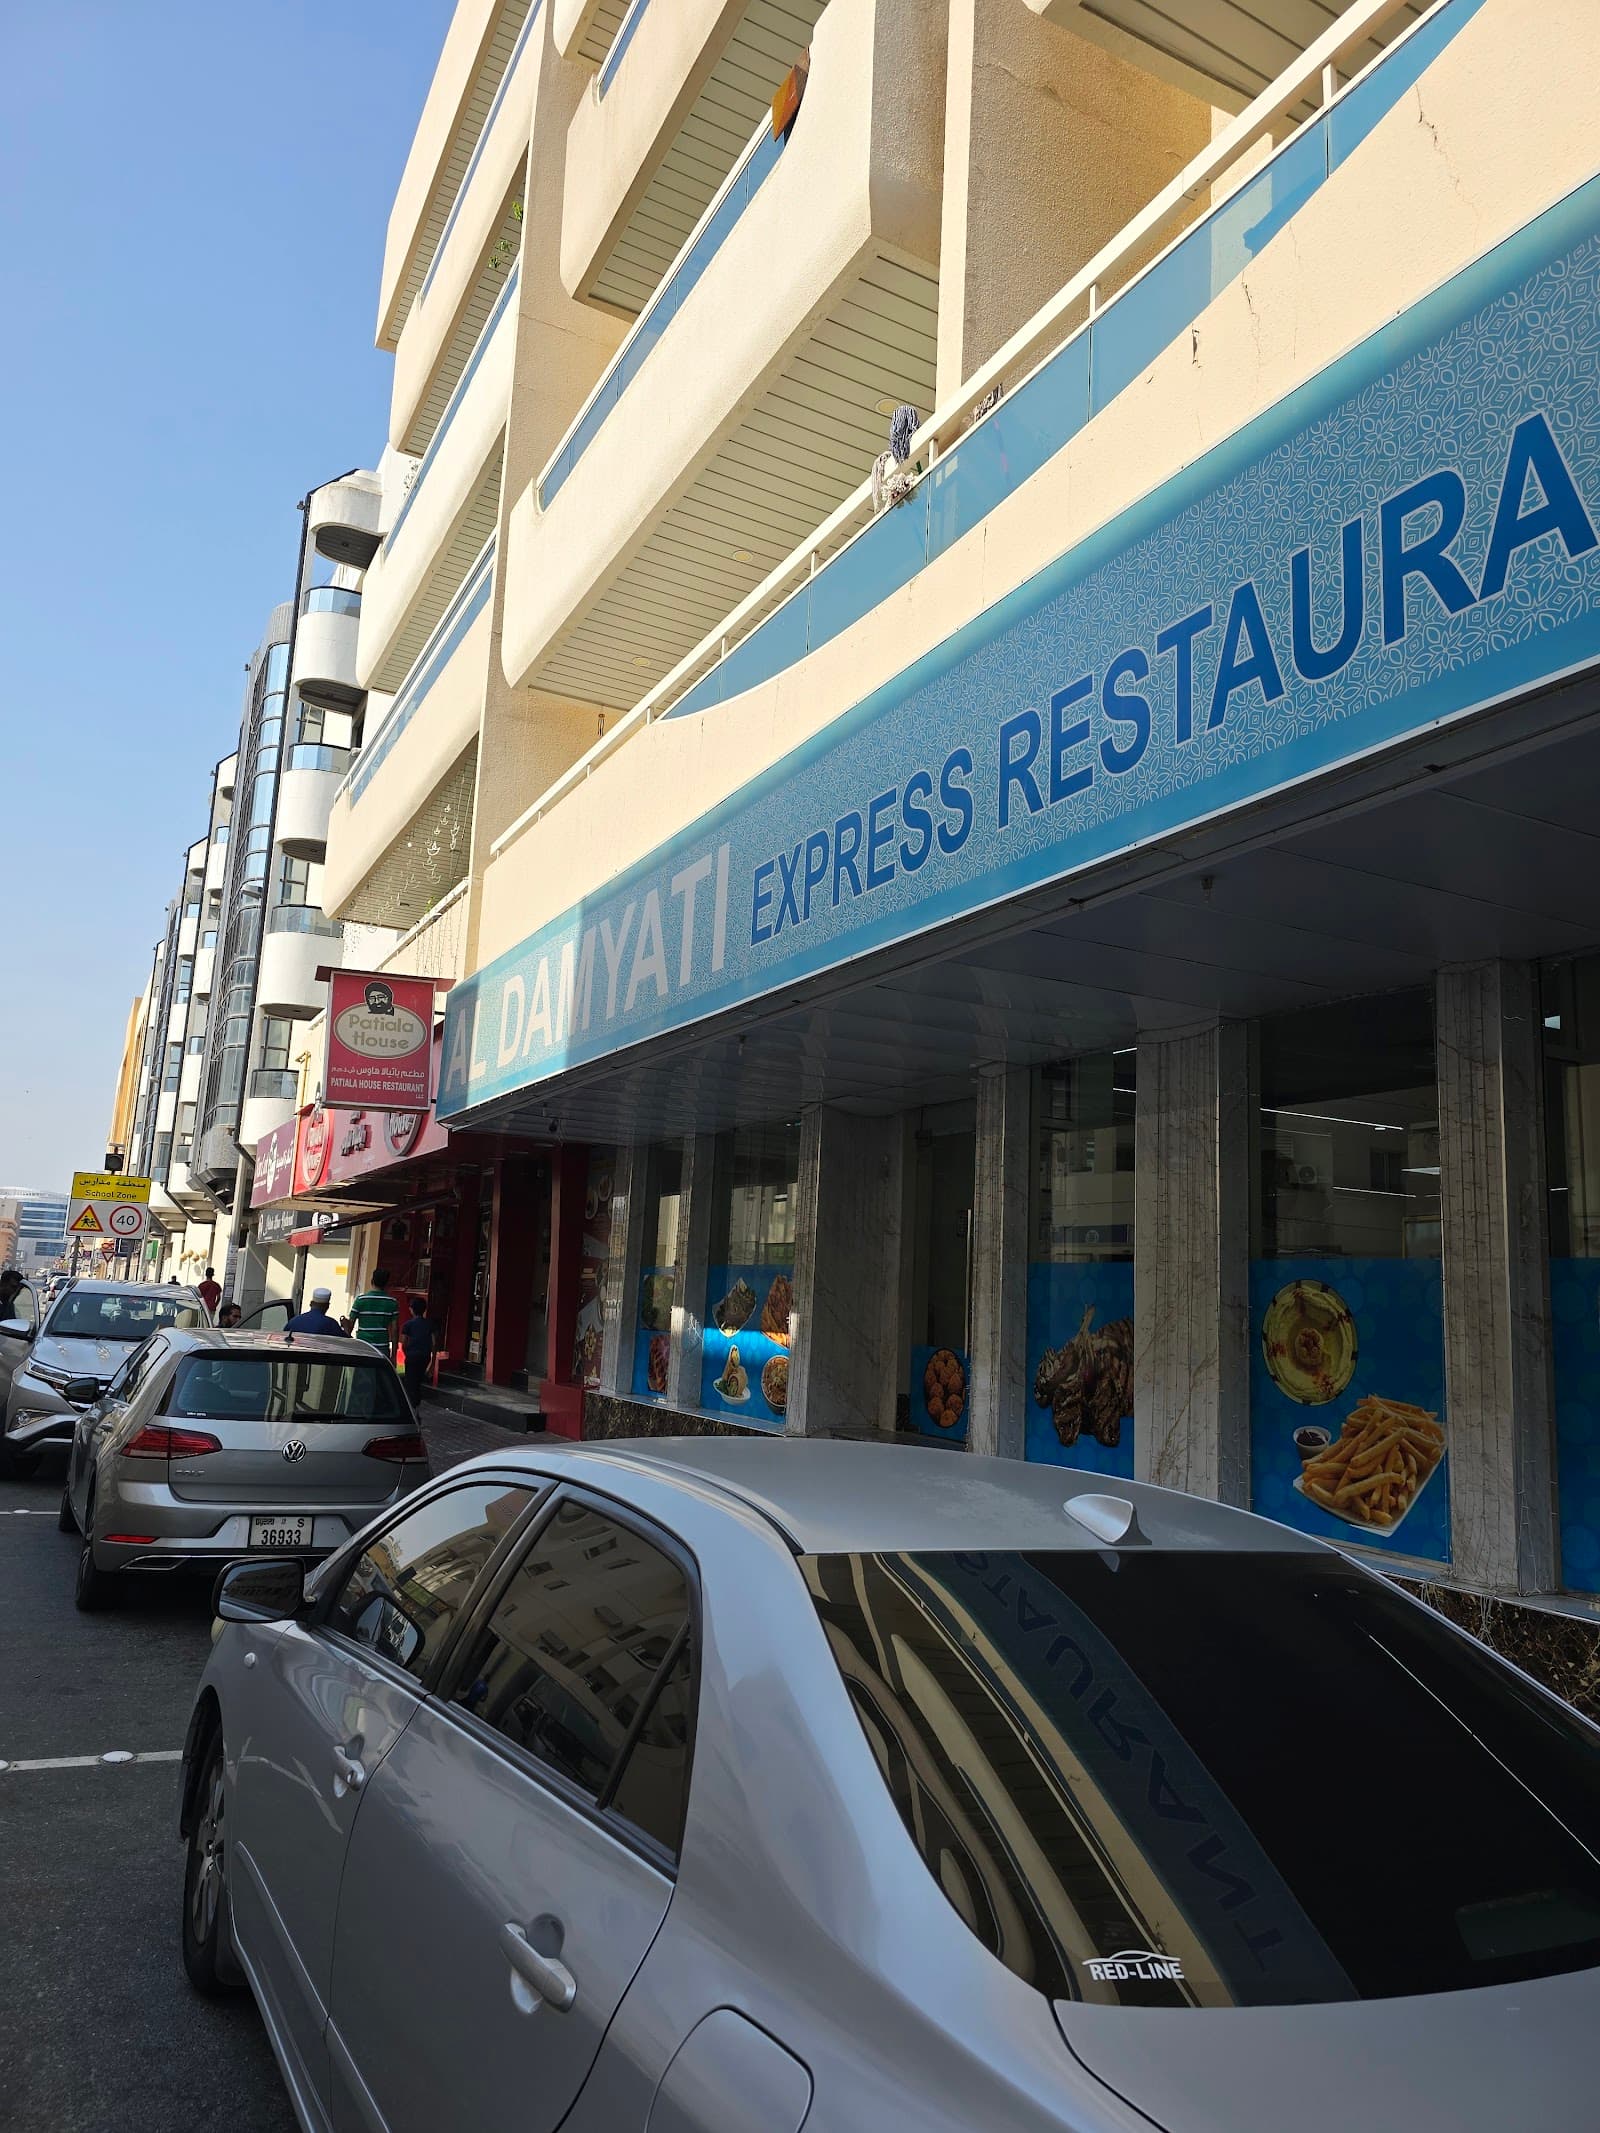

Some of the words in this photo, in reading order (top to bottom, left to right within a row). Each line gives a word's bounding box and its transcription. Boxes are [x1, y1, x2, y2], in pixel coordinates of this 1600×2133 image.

[446, 998, 487, 1092] AL
[497, 843, 731, 1069] DAMYATI
[750, 746, 974, 947] EXPRESS
[997, 410, 1600, 833] RESTAURA
[348, 1013, 414, 1033] Patiala
[352, 1031, 409, 1049] House
[356, 1066, 380, 1076] هاوس
[401, 1069, 425, 1079] مطعم
[330, 1077, 357, 1088] PATIALA
[359, 1079, 381, 1090] HOUSE
[382, 1081, 425, 1093] RESTAURANT
[79, 1177, 111, 1186] مدارس
[85, 1189, 114, 1198] School
[116, 1191, 137, 1199] Zone
[116, 1215, 135, 1226] 40
[297, 1518, 305, 1528] S
[261, 1529, 302, 1545] 36933
[1089, 1962, 1185, 1980] RED-LINE
